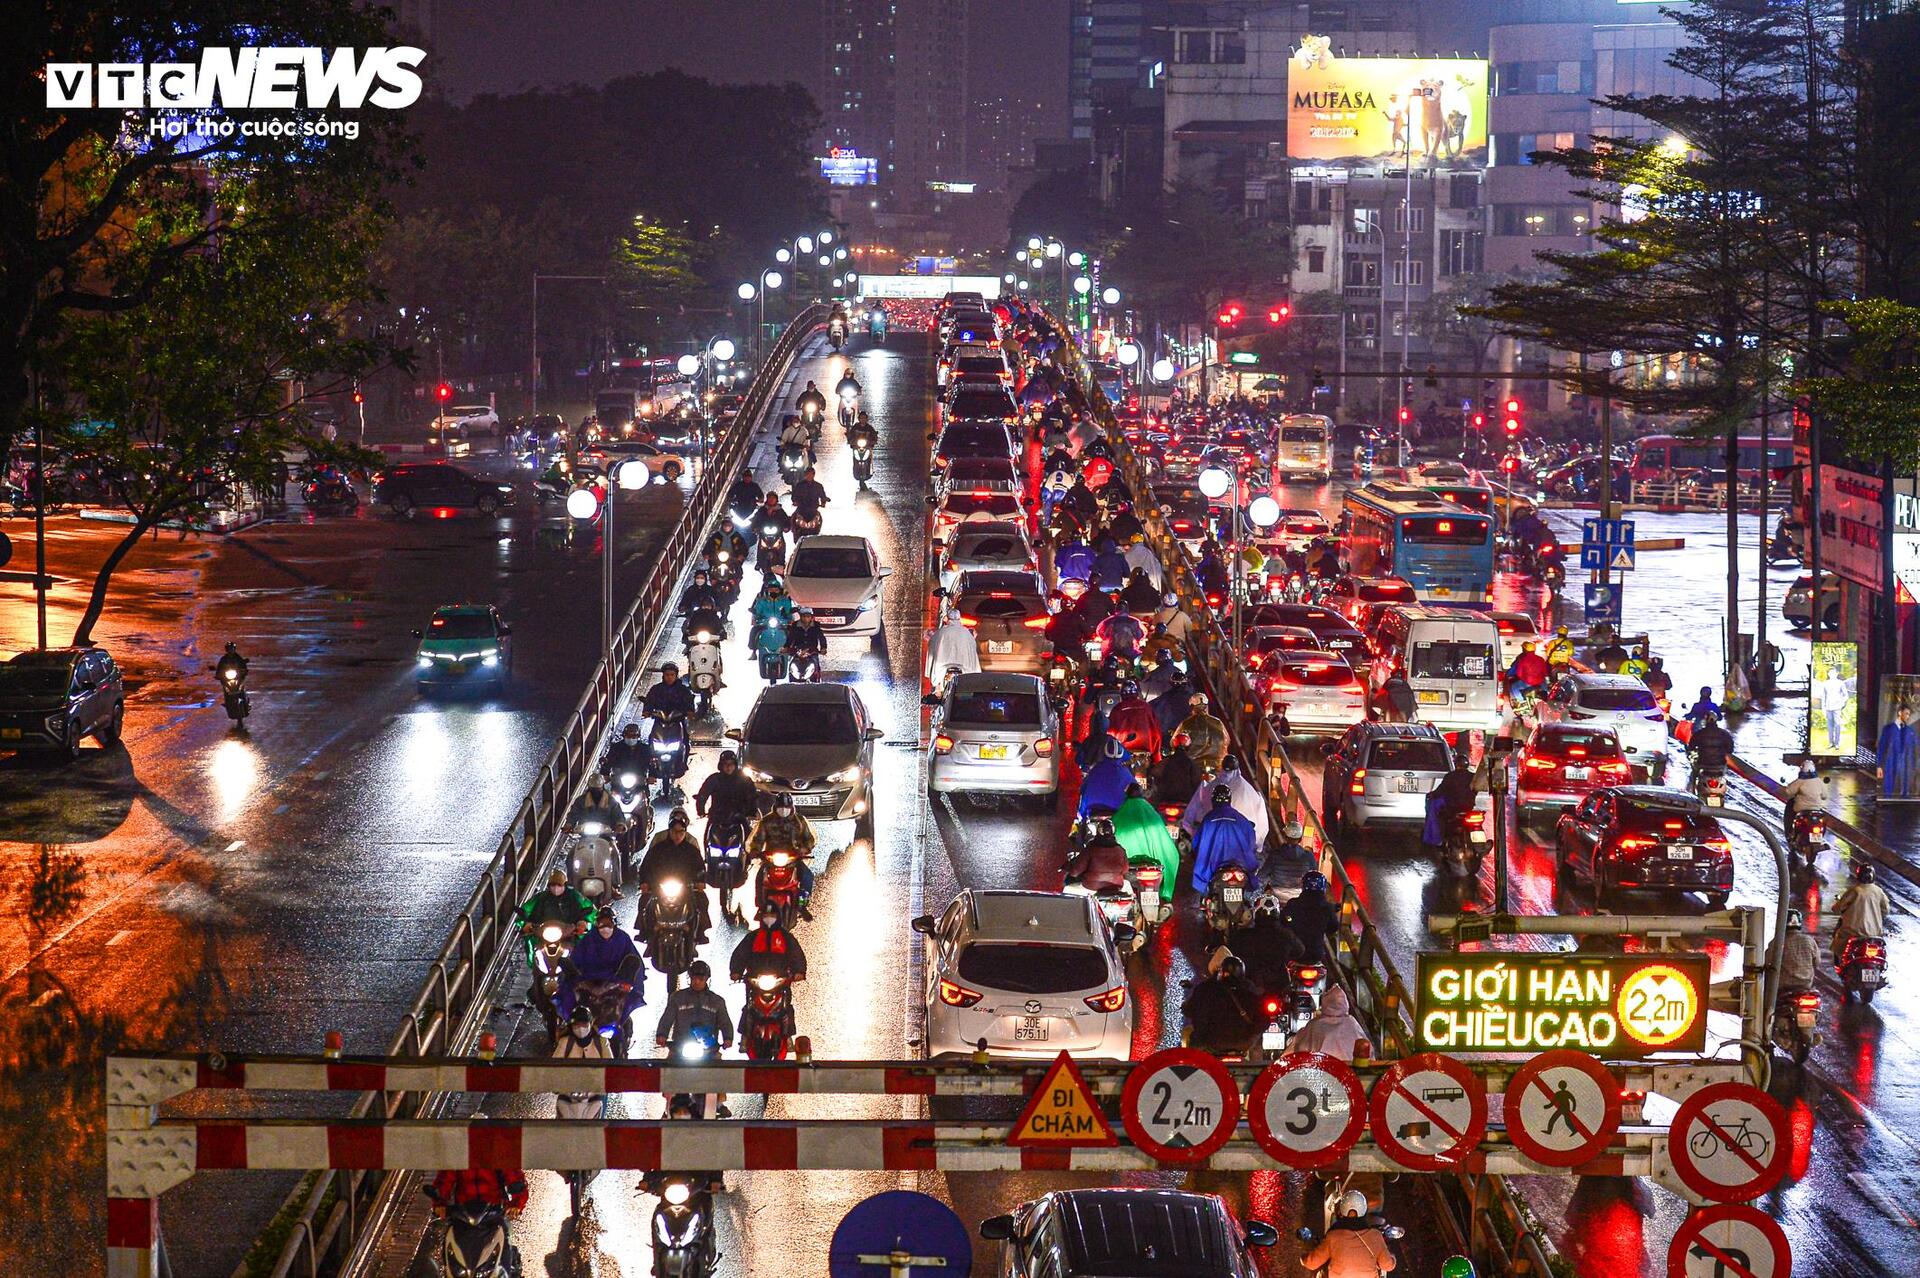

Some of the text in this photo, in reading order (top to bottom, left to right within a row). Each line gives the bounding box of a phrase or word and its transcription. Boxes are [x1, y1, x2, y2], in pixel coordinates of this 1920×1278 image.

[1293, 91, 1377, 109] MUFASA
[1431, 962, 1611, 1004] GIỚI HẠN
[1023, 1018, 1040, 1029] 30E
[1016, 1028, 1045, 1039] 575.11
[1052, 1089, 1074, 1108] ĐI
[1151, 1081, 1211, 1129] 2,2m
[1031, 1112, 1094, 1137] CHẬM
